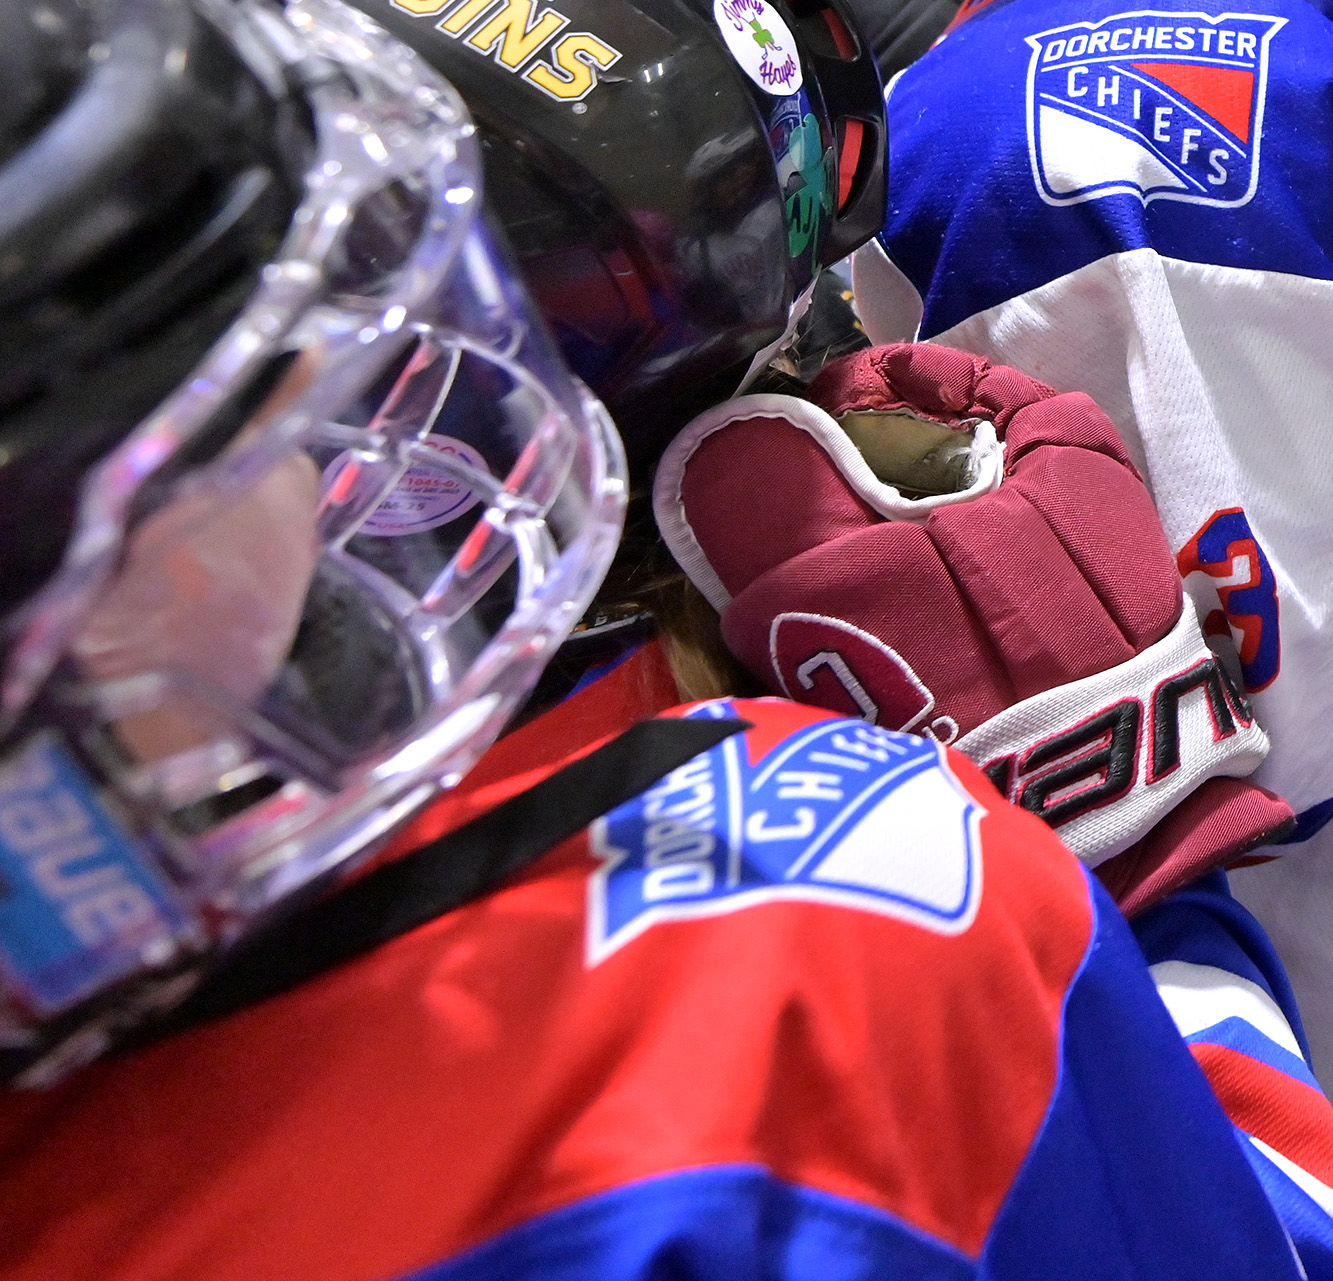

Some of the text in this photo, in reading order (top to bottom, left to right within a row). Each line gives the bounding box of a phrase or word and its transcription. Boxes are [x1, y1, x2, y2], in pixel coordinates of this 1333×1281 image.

[759, 53, 797, 89] Hayes
[1042, 26, 1257, 63] DORCHESTER
[1066, 66, 1230, 186] CHIEFS
[641, 750, 717, 902] DORCH
